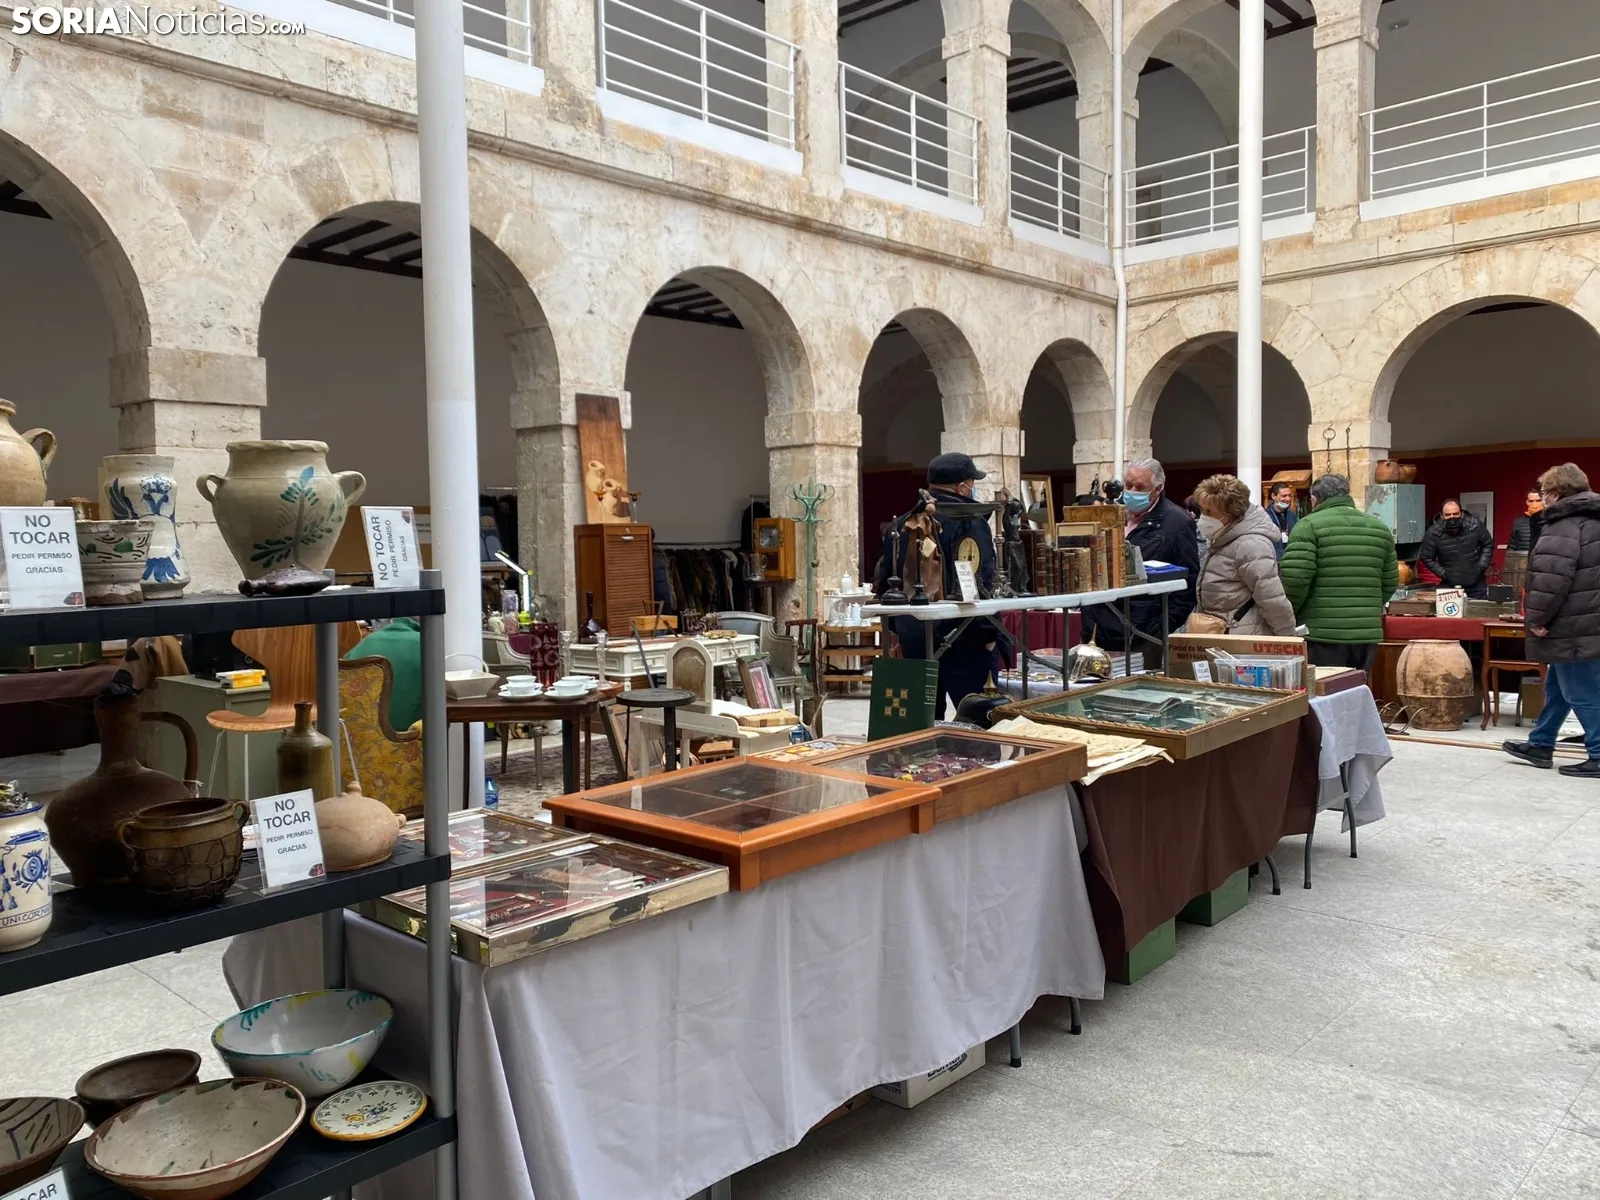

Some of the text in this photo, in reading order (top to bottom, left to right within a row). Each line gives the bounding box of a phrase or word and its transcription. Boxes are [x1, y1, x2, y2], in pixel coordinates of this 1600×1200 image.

[24, 514, 51, 528] NO
[9, 531, 71, 544] TOCAR
[371, 516, 389, 580] NO TOCAR
[385, 519, 399, 578] PEDIR PERMISO
[399, 535, 408, 562] GRACIAS
[25, 566, 64, 574] GRACIAS
[1445, 604, 1457, 615] gt
[1253, 643, 1304, 655] UTSCH
[274, 798, 295, 812] NO
[263, 811, 311, 829] TOCAR
[266, 829, 314, 843] PEDIR PERMISO
[277, 843, 307, 855] GRACIAS
